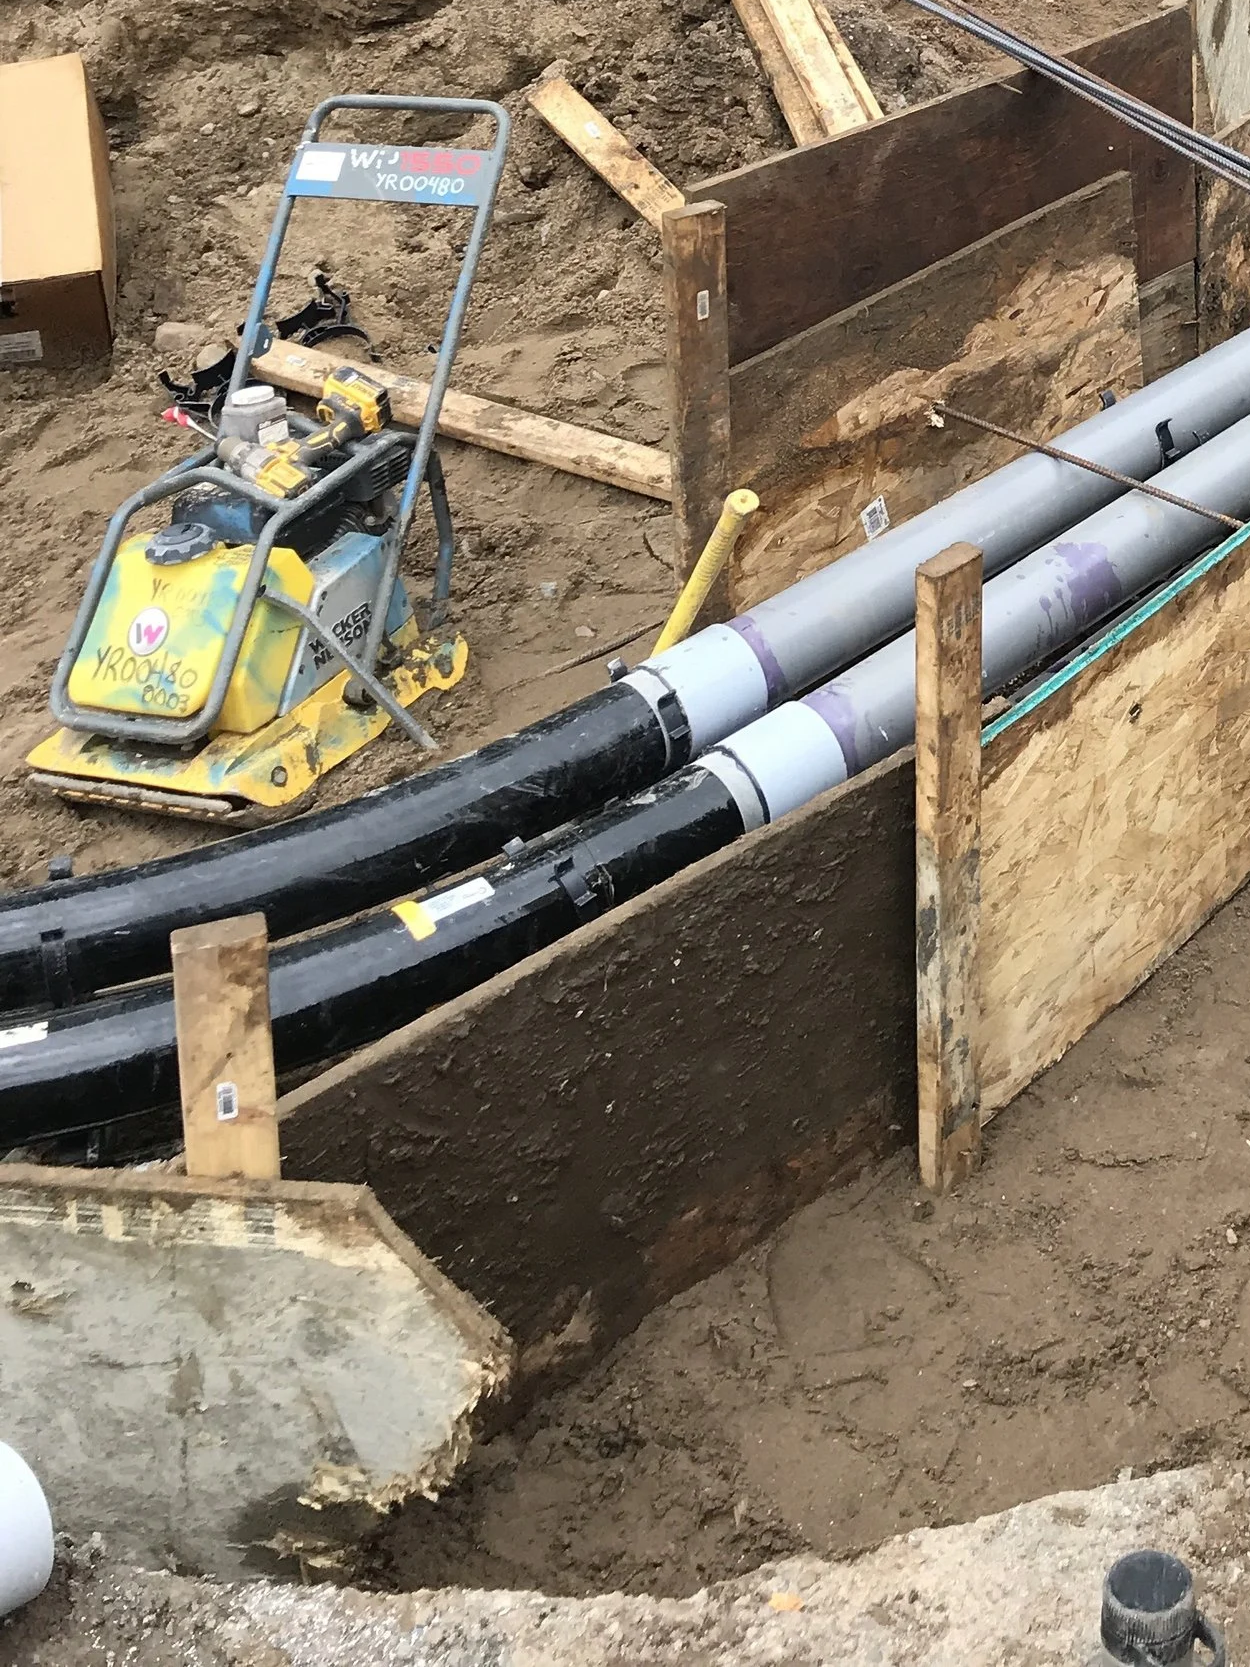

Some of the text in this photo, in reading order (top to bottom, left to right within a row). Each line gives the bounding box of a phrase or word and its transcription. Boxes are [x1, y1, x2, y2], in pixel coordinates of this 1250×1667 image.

[375, 172, 465, 197] YR00480
[307, 600, 374, 655] WCKER
[91, 644, 199, 689] YR00480
